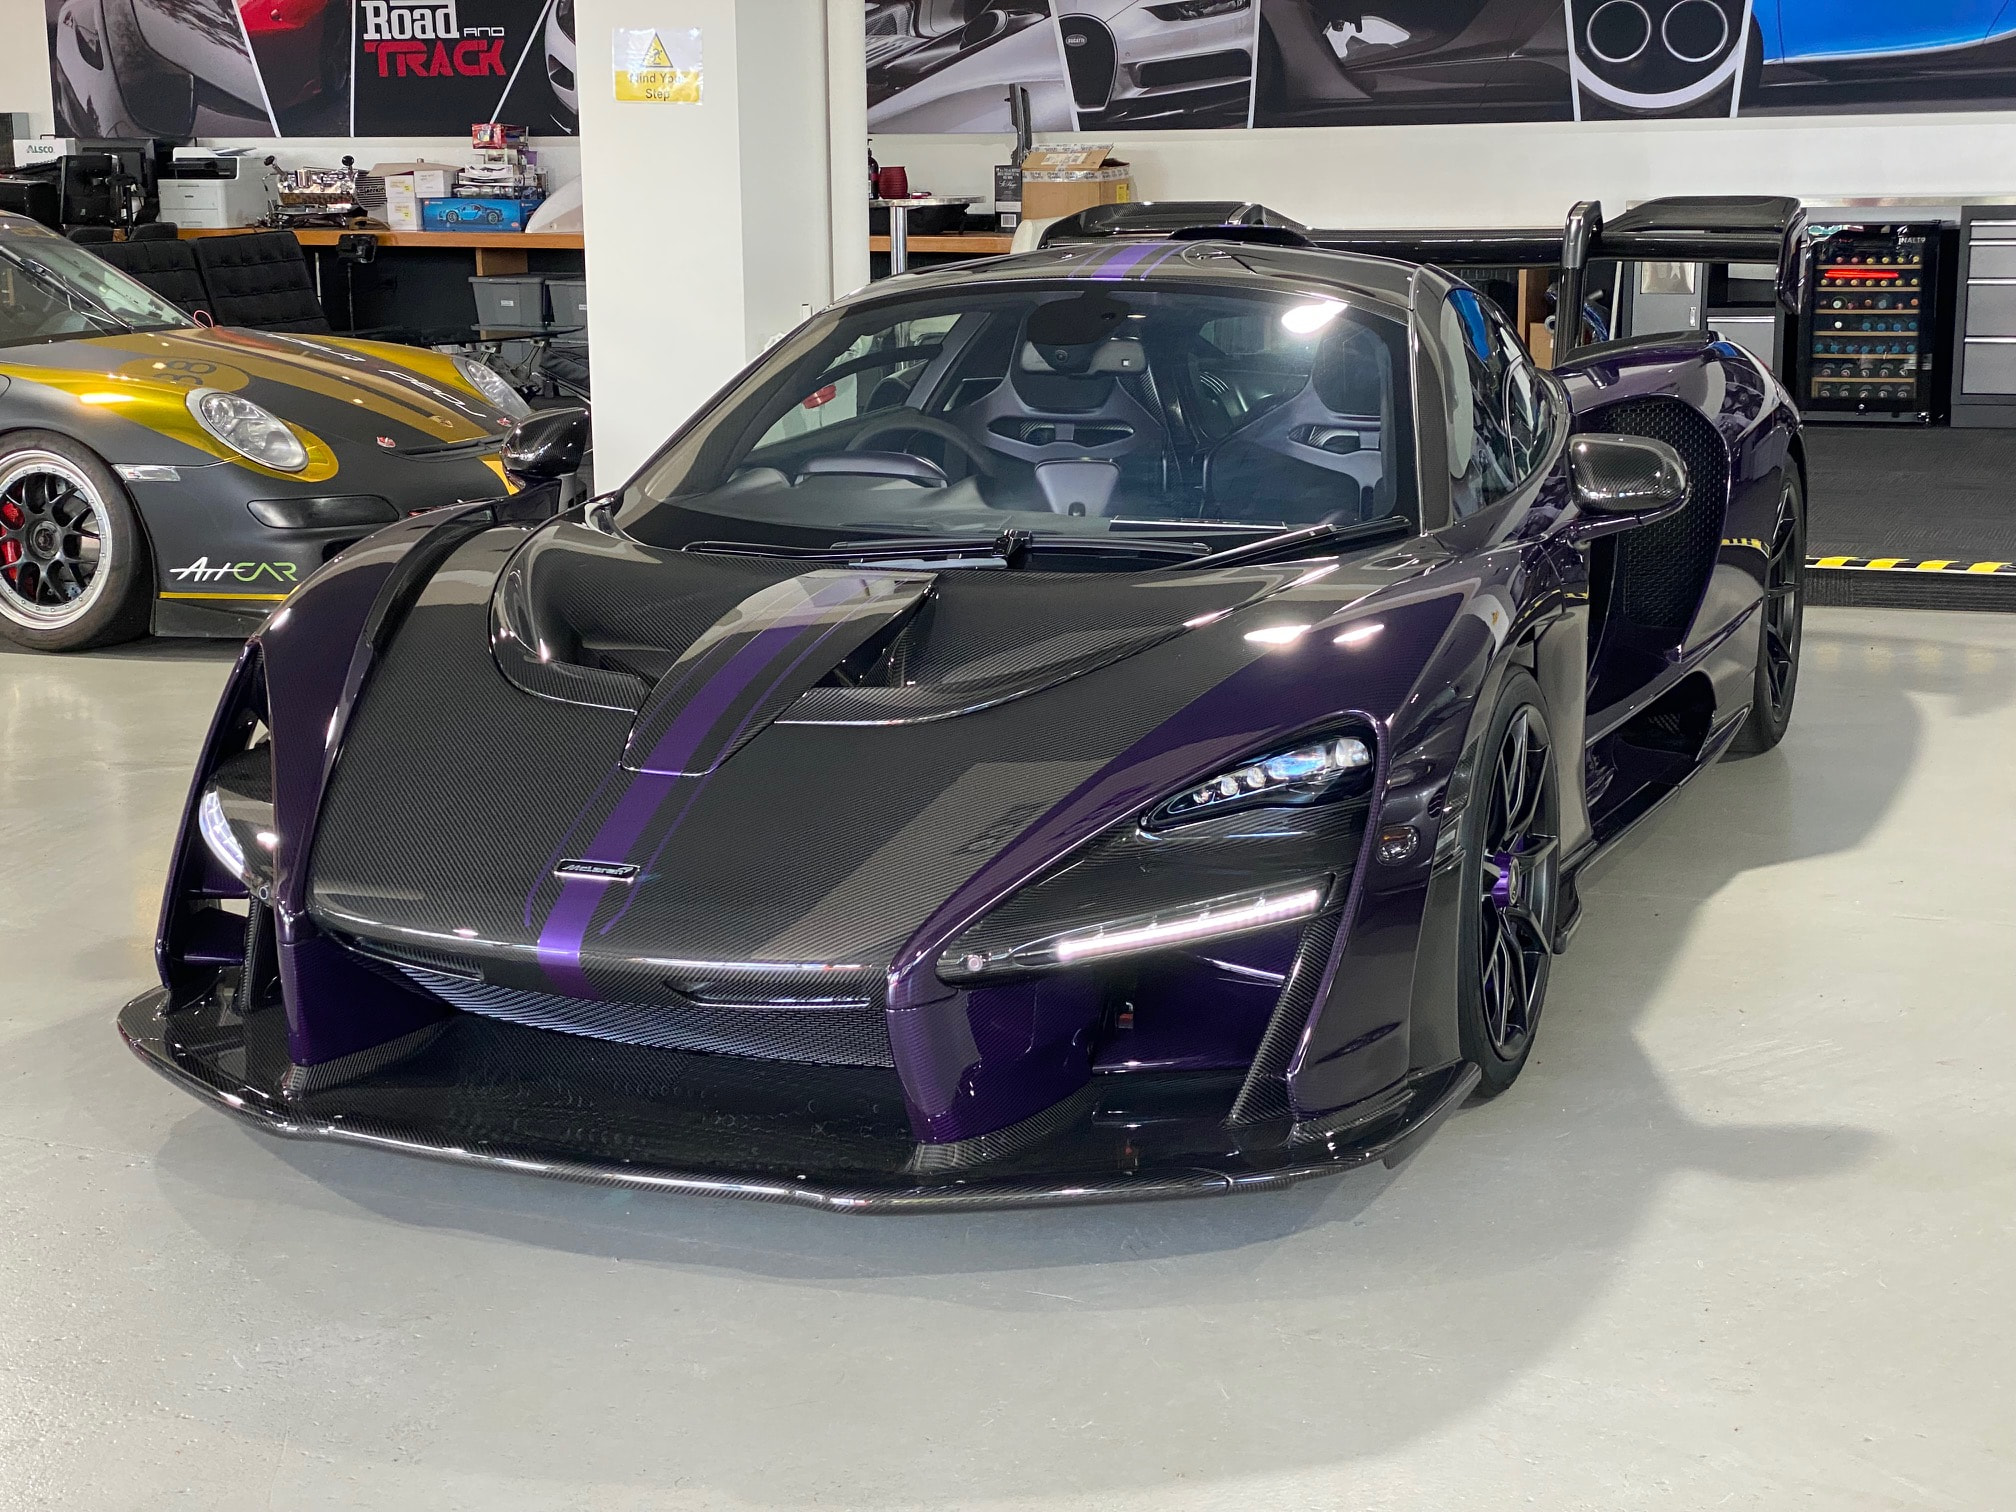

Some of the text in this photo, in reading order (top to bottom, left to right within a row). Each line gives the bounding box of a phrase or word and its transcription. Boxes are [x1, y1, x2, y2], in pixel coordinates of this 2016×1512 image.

[361, 0, 460, 40] Road
[363, 39, 507, 78] TRACK
[645, 88, 670, 101] Step
[26, 145, 54, 153] ALSCO
[562, 864, 627, 875] McLaren
